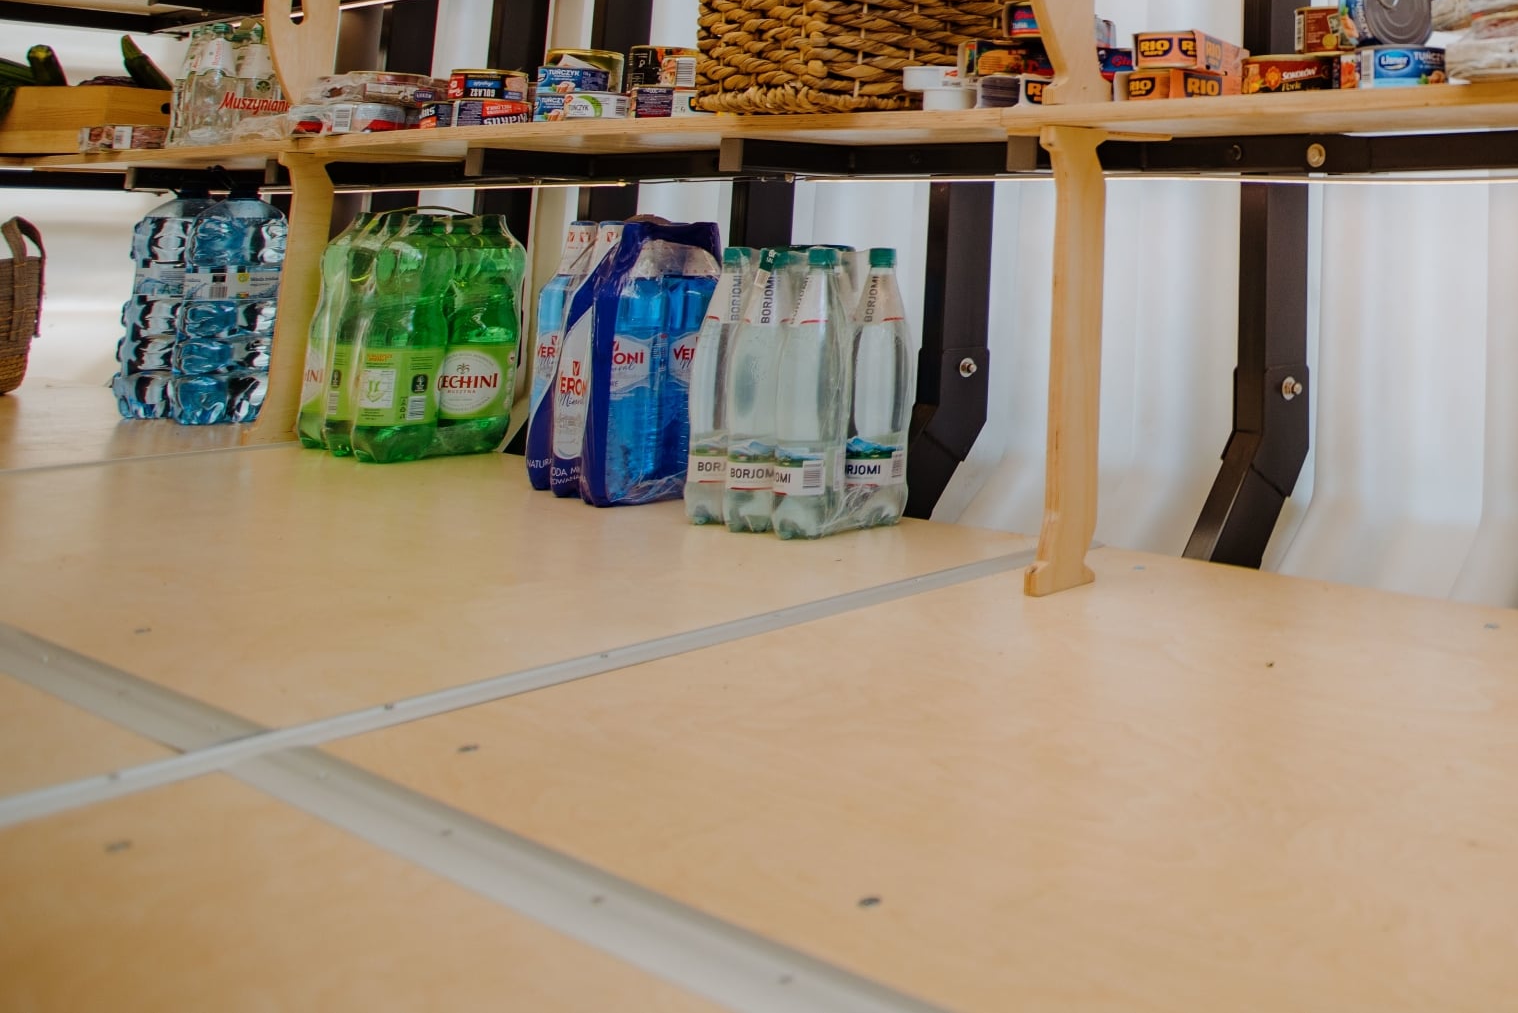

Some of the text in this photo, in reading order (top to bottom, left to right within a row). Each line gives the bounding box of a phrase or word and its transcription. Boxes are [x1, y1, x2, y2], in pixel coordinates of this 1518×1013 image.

[1139, 39, 1171, 52] RIO
[470, 88, 496, 98] GULASZ
[1129, 79, 1152, 92] RIO
[1186, 78, 1220, 96] RIO
[730, 274, 743, 322] BORJOMI
[760, 276, 775, 324] BORJOMI
[864, 275, 879, 323] BORJOMI
